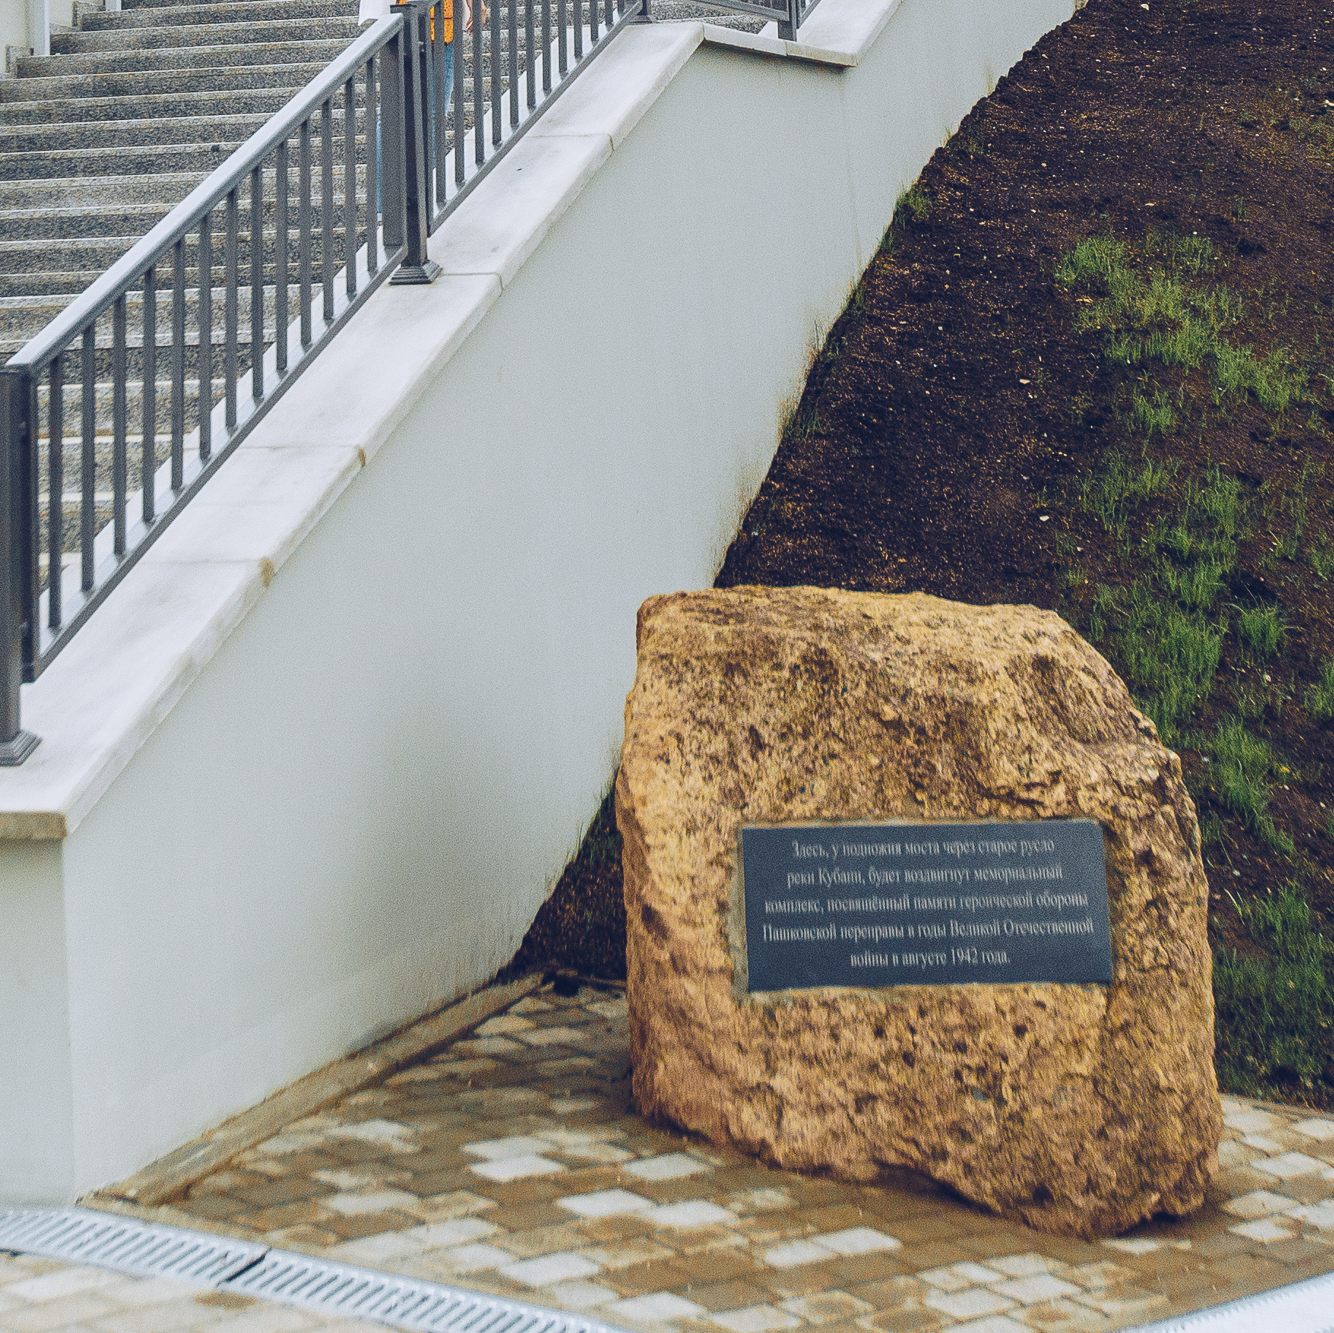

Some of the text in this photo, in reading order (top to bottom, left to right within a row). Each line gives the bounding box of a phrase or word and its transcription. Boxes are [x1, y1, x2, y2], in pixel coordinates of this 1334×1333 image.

[792, 839, 1056, 860] Здесь, у подножия моста через старое русло
[787, 862, 1063, 889] реки Кубани, будет воздвигнут мемориальный
[764, 890, 1089, 916] комплекс, посвящённый памяти героической обороны
[762, 916, 1095, 943] Пашковской переправы в годы Великой Отечественной
[850, 946, 1011, 970] войны в августе 1942 года.
